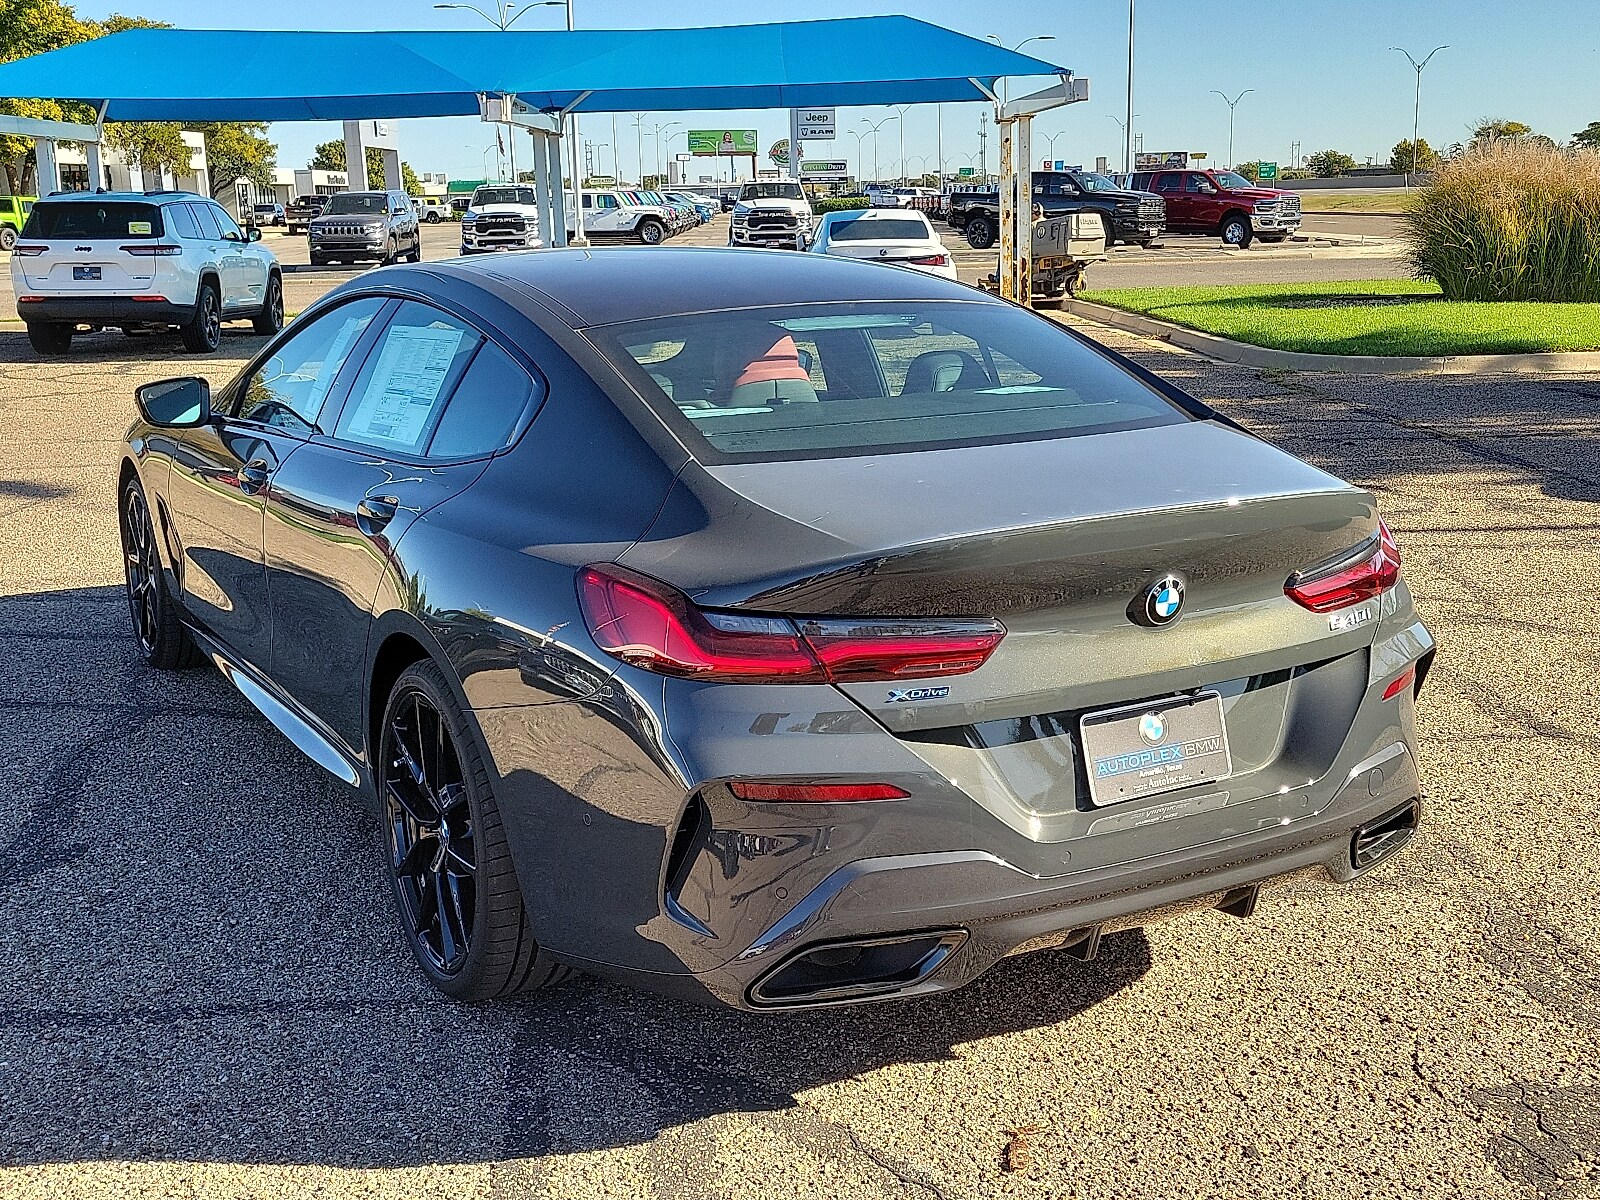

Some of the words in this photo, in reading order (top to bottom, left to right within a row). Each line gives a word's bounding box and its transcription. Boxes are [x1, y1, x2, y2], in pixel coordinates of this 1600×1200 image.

[805, 113, 828, 122] Jeep
[1097, 746, 1183, 774] AUTOPLEX
[1185, 738, 1220, 756] BMW
